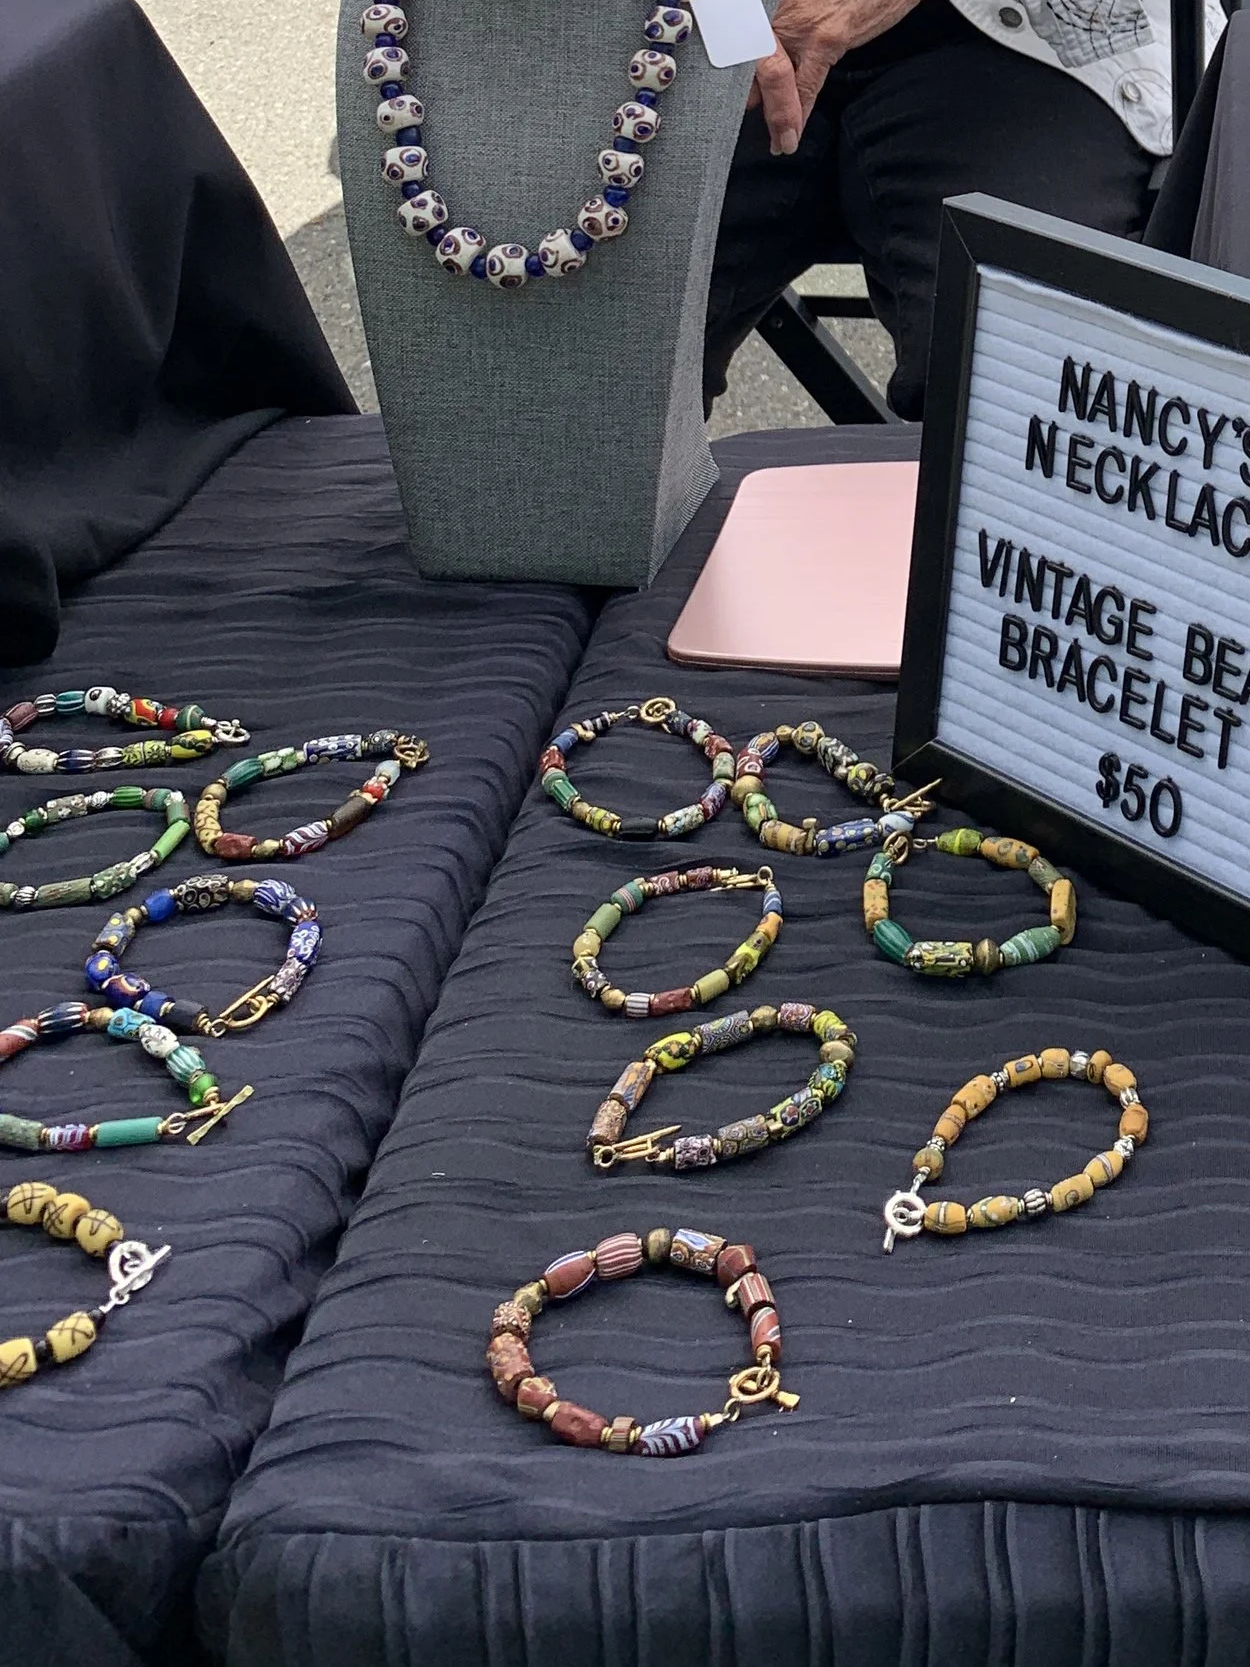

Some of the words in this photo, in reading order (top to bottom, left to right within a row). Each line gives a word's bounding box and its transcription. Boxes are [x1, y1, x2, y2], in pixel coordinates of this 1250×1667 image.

[978, 529, 1157, 662] VINTAGE
[998, 613, 1243, 770] BRACELET
[1095, 752, 1183, 839] $50
